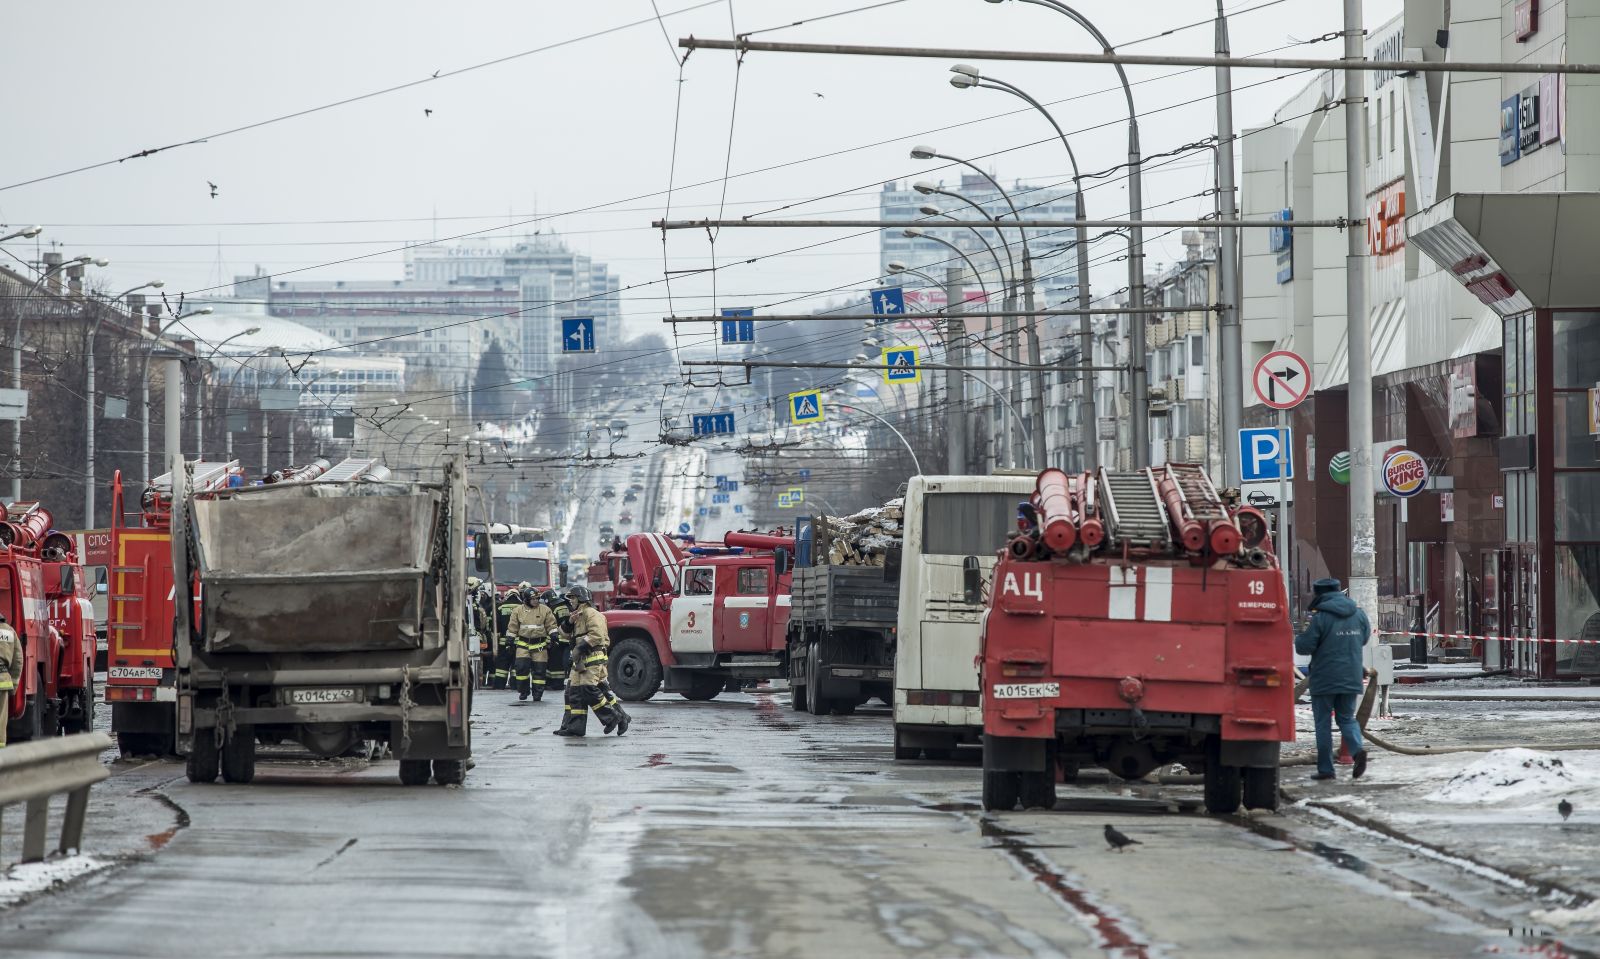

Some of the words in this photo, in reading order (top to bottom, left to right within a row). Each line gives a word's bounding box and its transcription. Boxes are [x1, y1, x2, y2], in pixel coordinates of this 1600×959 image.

[1252, 434, 1280, 475] P
[1388, 460, 1422, 478] BURGER
[1390, 467, 1424, 489] KING
[1003, 572, 1043, 602] АЦ
[1248, 581, 1265, 595] 19
[1238, 601, 1277, 609] КЕМЕРОВО
[687, 611, 696, 628] 3
[111, 668, 146, 677] С704АР
[999, 685, 1042, 697] А015ЕК
